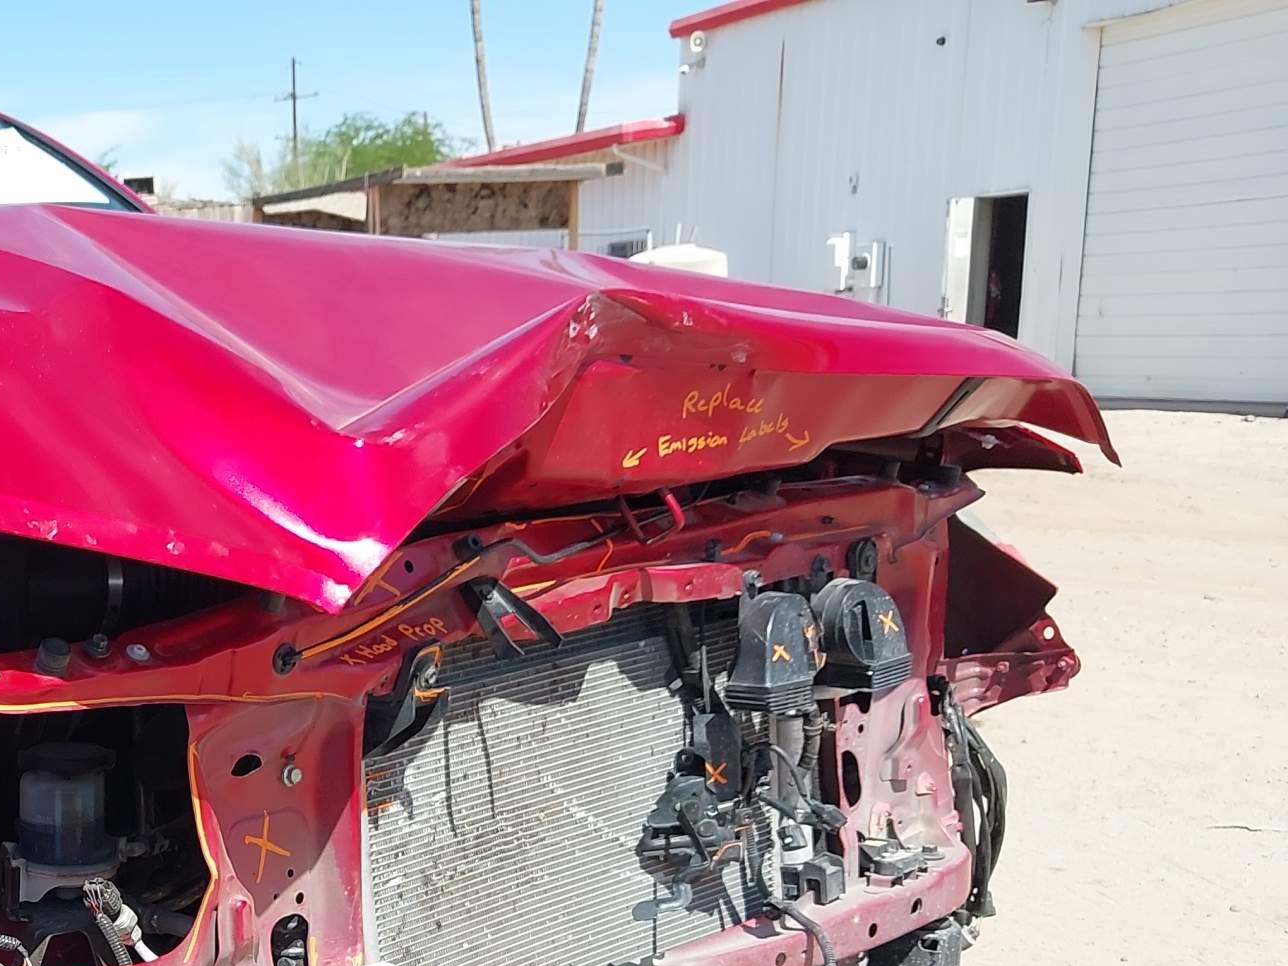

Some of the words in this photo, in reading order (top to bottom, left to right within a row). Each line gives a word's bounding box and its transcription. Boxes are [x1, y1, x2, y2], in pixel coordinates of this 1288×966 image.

[682, 383, 765, 419] Replace
[361, 634, 398, 659] Hood
[397, 616, 448, 641] Prop
